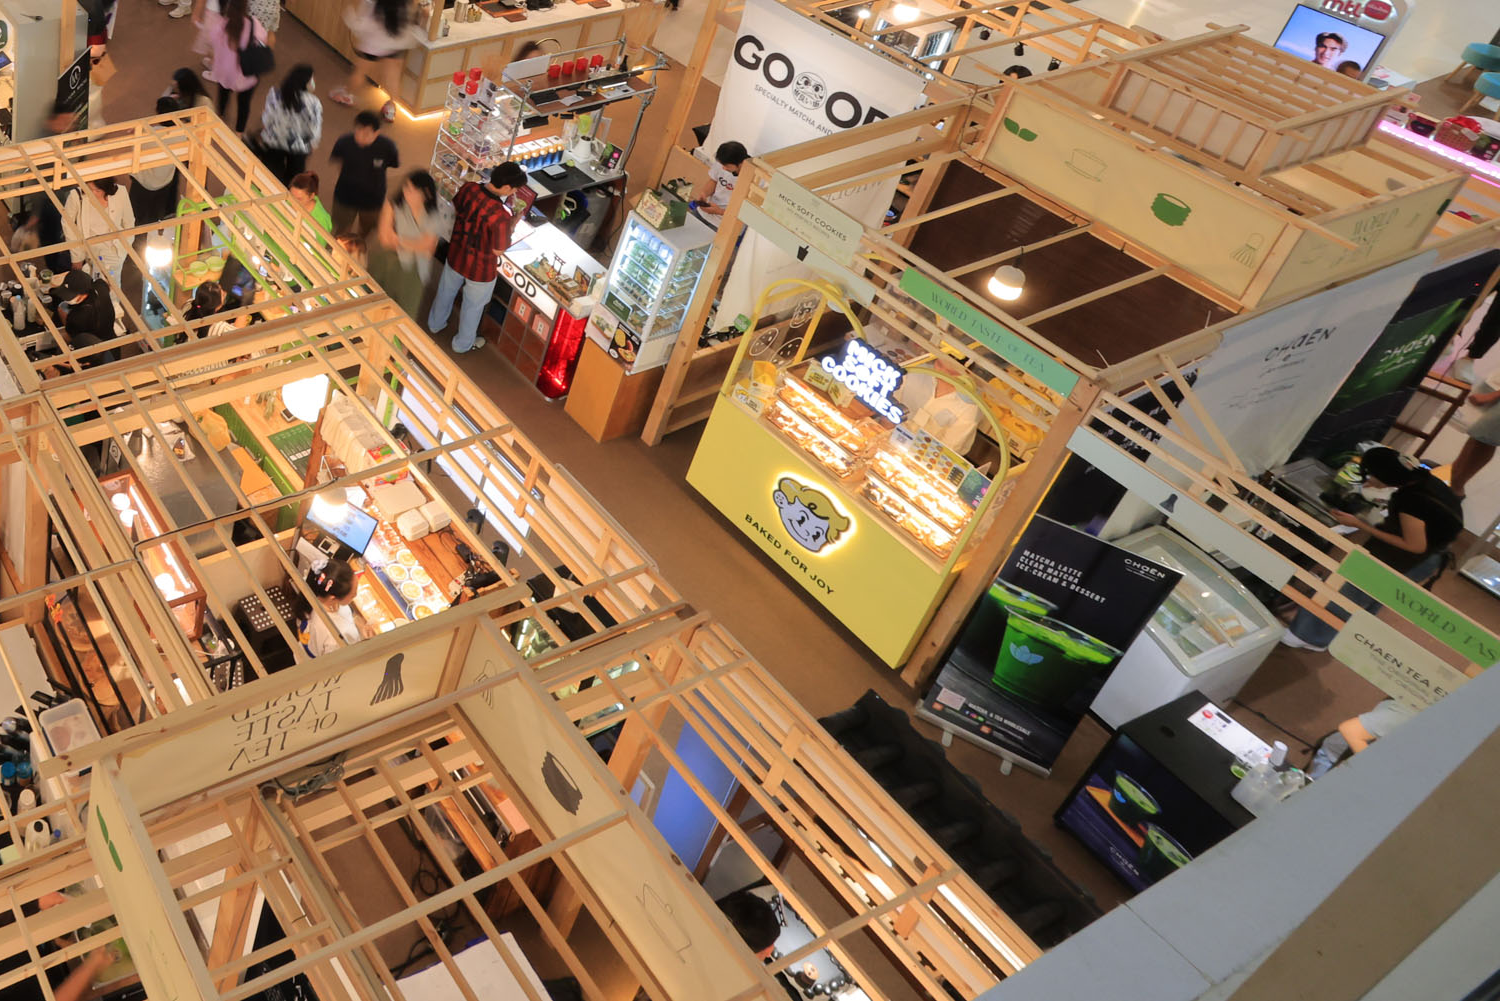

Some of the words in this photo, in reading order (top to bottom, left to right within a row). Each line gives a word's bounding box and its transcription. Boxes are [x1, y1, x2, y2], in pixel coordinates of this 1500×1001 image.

[754, 84, 790, 109] SPECIALTY
[788, 105, 816, 127] MATCHA
[816, 123, 834, 137] AND
[779, 193, 796, 207] MICK
[797, 205, 814, 219] SOFT
[814, 217, 847, 242] COOKIES
[931, 291, 967, 321] WORLD
[971, 318, 1002, 345] TASTE
[1023, 353, 1045, 373] TEA
[842, 355, 894, 398] SOFT
[847, 339, 901, 387] MICK
[821, 356, 903, 424] COOKIES
[745, 513, 782, 549] BAKED
[784, 549, 808, 573] FOR
[809, 574, 835, 595] JOY
[1019, 556, 1045, 570] CLEAR
[1046, 567, 1079, 584] MATCHA
[1023, 550, 1055, 568] MATCHA
[1057, 563, 1083, 578] LATTE
[1016, 562, 1059, 585] ICE-CREAM
[1069, 583, 1107, 604] DESSERT
[1396, 588, 1456, 634] WORLD
[1354, 632, 1403, 668] CHAEN
[1406, 666, 1430, 688] TEA
